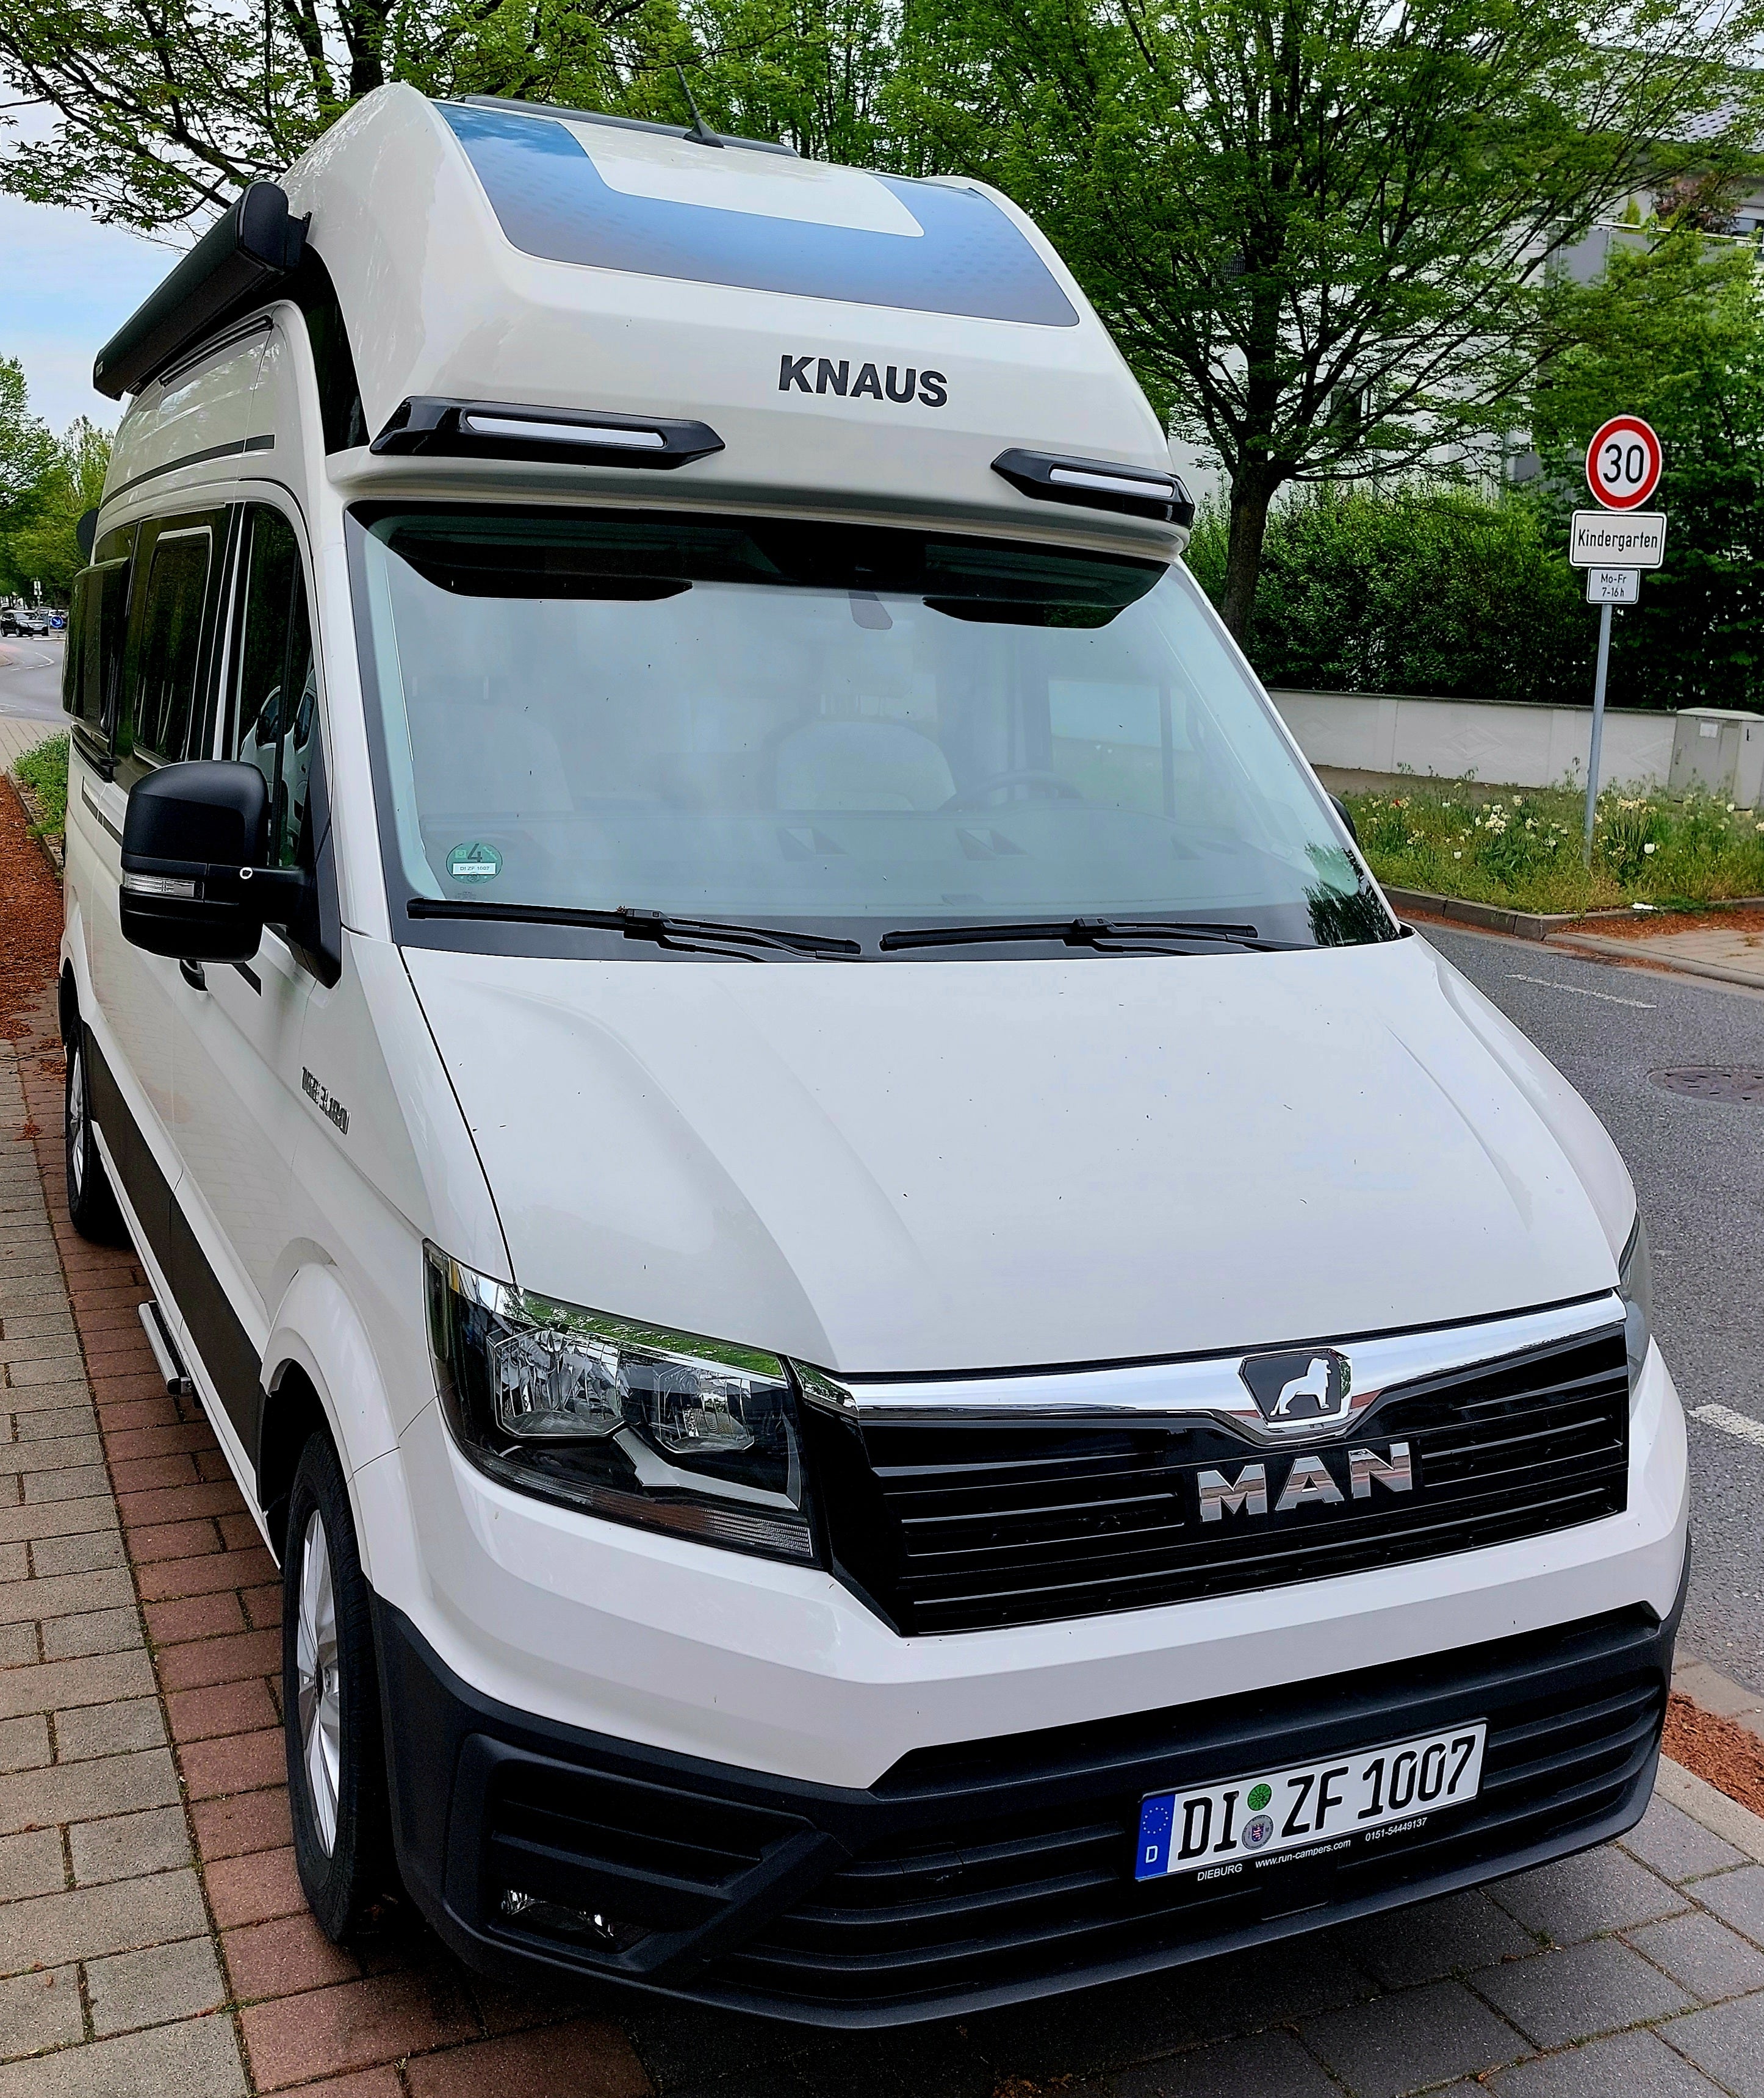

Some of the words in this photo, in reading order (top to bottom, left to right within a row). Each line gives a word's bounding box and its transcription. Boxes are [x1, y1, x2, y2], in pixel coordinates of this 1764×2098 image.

[779, 354, 947, 407] KNAUS
[1603, 444, 1644, 483] 30
[1578, 529, 1658, 551] Kindergarten
[1600, 573, 1627, 584] Mo-Fr
[467, 844, 482, 862] 4
[1198, 1442, 1413, 1522] MAN
[1178, 1790, 1240, 1861] DI
[1281, 1766, 1349, 1838] ZF
[1357, 1734, 1476, 1820] 1007
[1145, 1845, 1157, 1863] D
[1197, 1863, 1243, 1881] DIEBURG
[1255, 1839, 1351, 1869] www.run-campers.com
[1365, 1817, 1427, 1842] 0151-54449137
